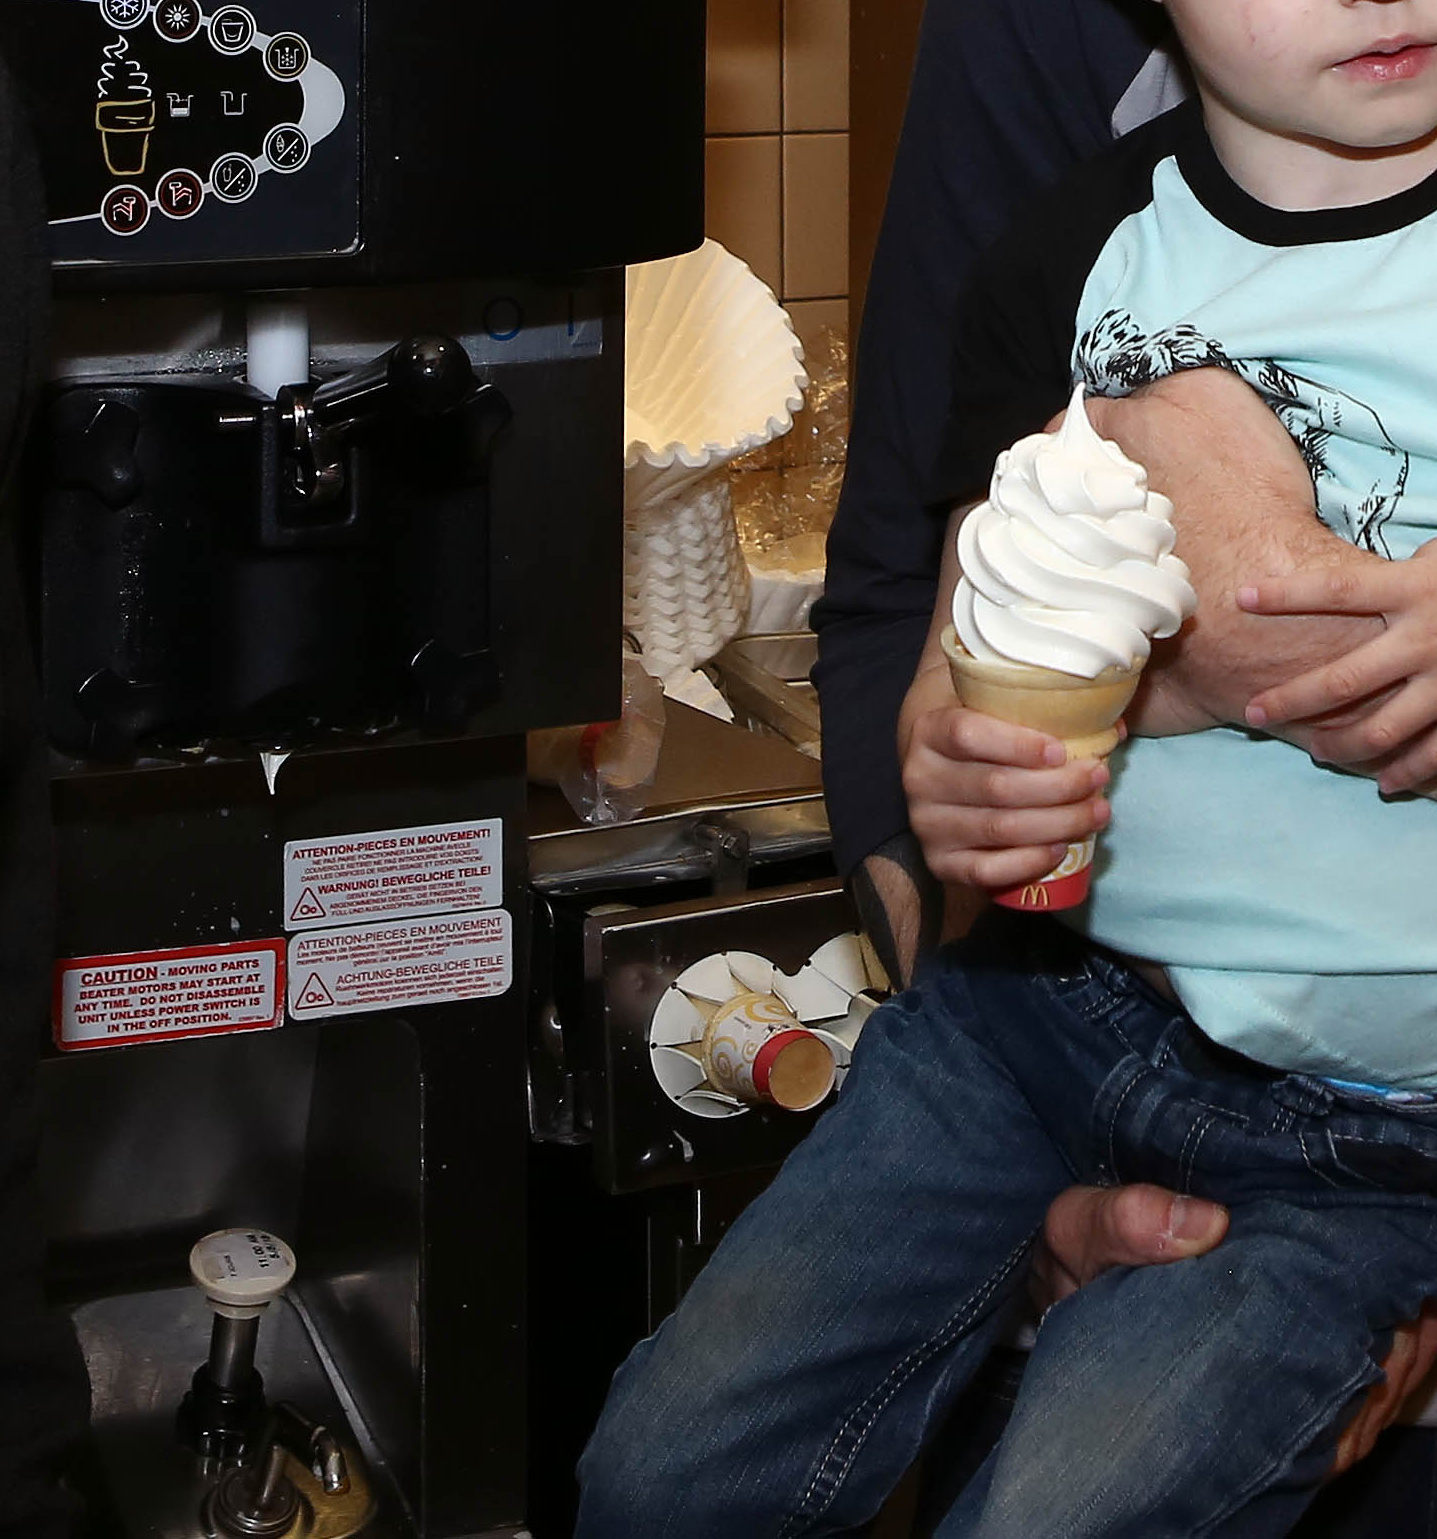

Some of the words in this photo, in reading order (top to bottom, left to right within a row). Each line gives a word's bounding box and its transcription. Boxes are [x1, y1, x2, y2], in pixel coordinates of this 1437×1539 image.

[292, 839, 397, 860] ATTENTION-PIECES
[400, 837, 415, 847] EN
[418, 828, 491, 844] MOUVEMENT!
[318, 879, 379, 894] WARNUNG!
[382, 869, 455, 886] BEWEGLICHE
[458, 866, 491, 878] TEILE!
[297, 928, 407, 950] ATTENTION-PIECES
[410, 926, 426, 937] EN
[429, 917, 502, 934] MOUVEMENT
[81, 966, 158, 986] CAUTION
[168, 964, 217, 976] MOVING
[221, 959, 260, 971] PARTS
[336, 959, 470, 984] ACHTUNG-BEWEGLICHE
[473, 955, 504, 967] TEILE
[74, 1002, 99, 1012] ANY
[102, 999, 133, 1009] TIME.
[140, 996, 156, 1006] DO
[160, 993, 184, 1003] NOT
[187, 985, 265, 1001] DISASSEMBLE
[80, 987, 125, 1000] BEATER
[128, 982, 176, 995] MOTORS
[180, 979, 203, 989] MAY
[207, 975, 243, 987] START
[246, 973, 261, 983] AT
[78, 1013, 107, 1024] UNIT
[110, 1009, 155, 1020] UNLESS
[159, 1004, 199, 1015] POWER
[203, 998, 246, 1011] SWITCH
[249, 997, 260, 1006] IS
[107, 1024, 120, 1033] IN
[123, 1021, 146, 1031] THE
[149, 1018, 171, 1029] OFF
[174, 1012, 232, 1026] POSITION.
